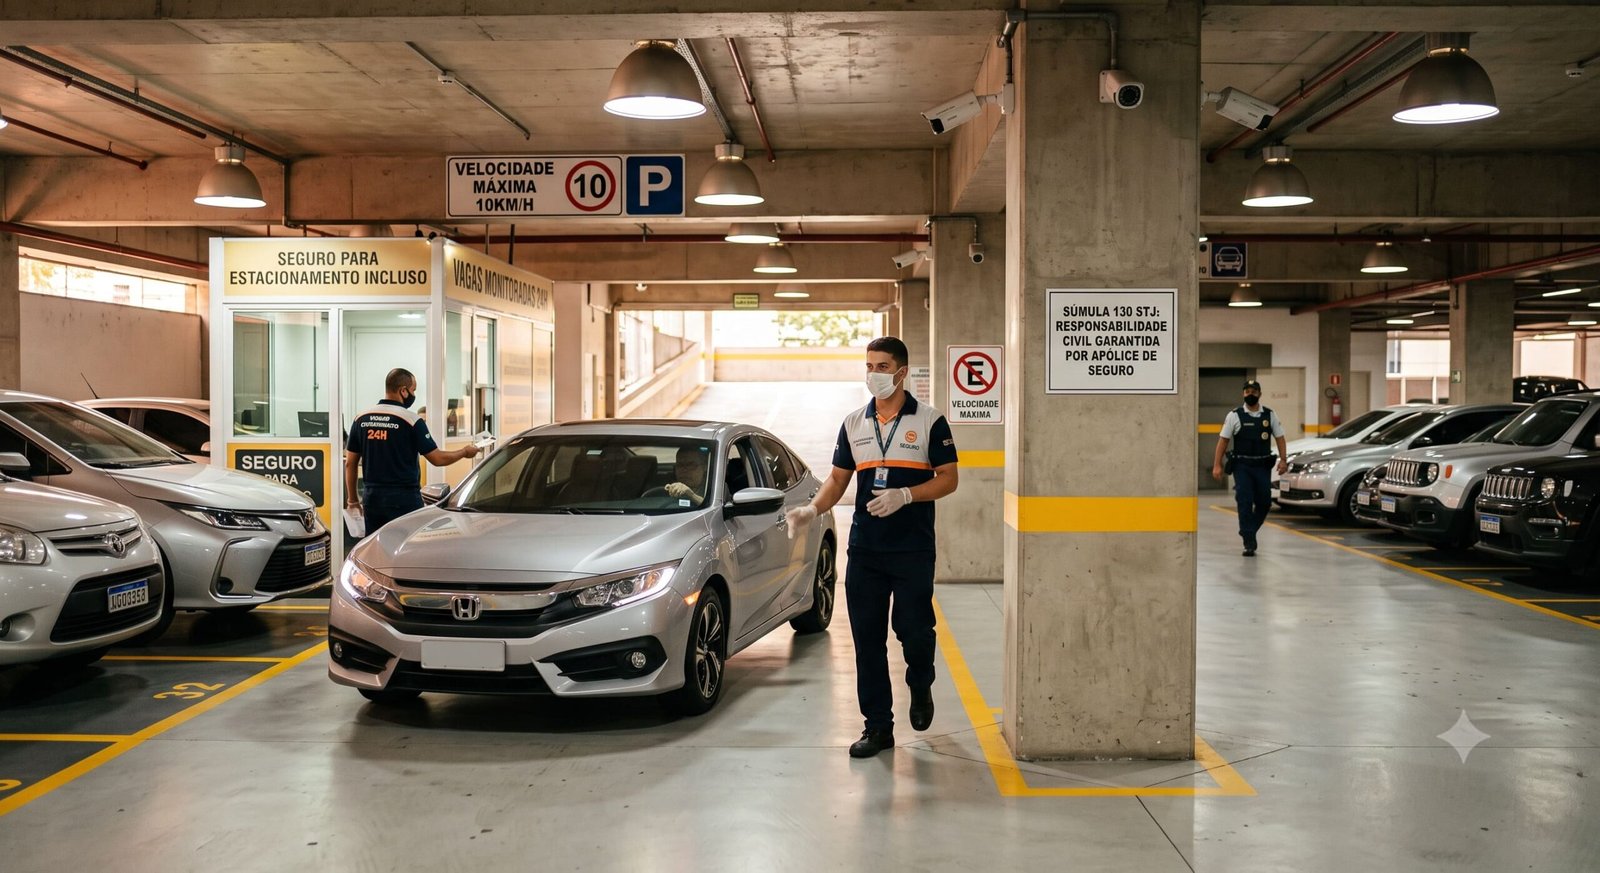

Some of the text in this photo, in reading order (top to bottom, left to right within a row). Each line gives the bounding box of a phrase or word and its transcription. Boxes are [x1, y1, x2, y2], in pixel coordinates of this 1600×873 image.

[455, 161, 554, 176] VELOCIDADE
[473, 177, 537, 194] MÁXIMA
[573, 173, 607, 199] 10
[639, 165, 672, 207] P
[475, 198, 534, 212] 10KM/H
[278, 251, 379, 266] SEGURO PARA
[230, 270, 427, 285] ESTACIONAMENTO INCLUSO
[453, 258, 549, 311] VAGAS MONITORADAS 24H
[1063, 304, 1160, 317] SÚMULA 130 STJ:
[1056, 320, 1168, 332] RESPONSABILIDADE
[1063, 335, 1160, 347] CIVIL GARANTIDA
[1065, 348, 1157, 361] POR APÓLICE DE
[1088, 365, 1134, 376] SEGURO
[952, 400, 999, 408] VELOCIDADE
[367, 429, 388, 440] 24H
[241, 455, 317, 470] SEGURO
[153, 681, 225, 699] 32
